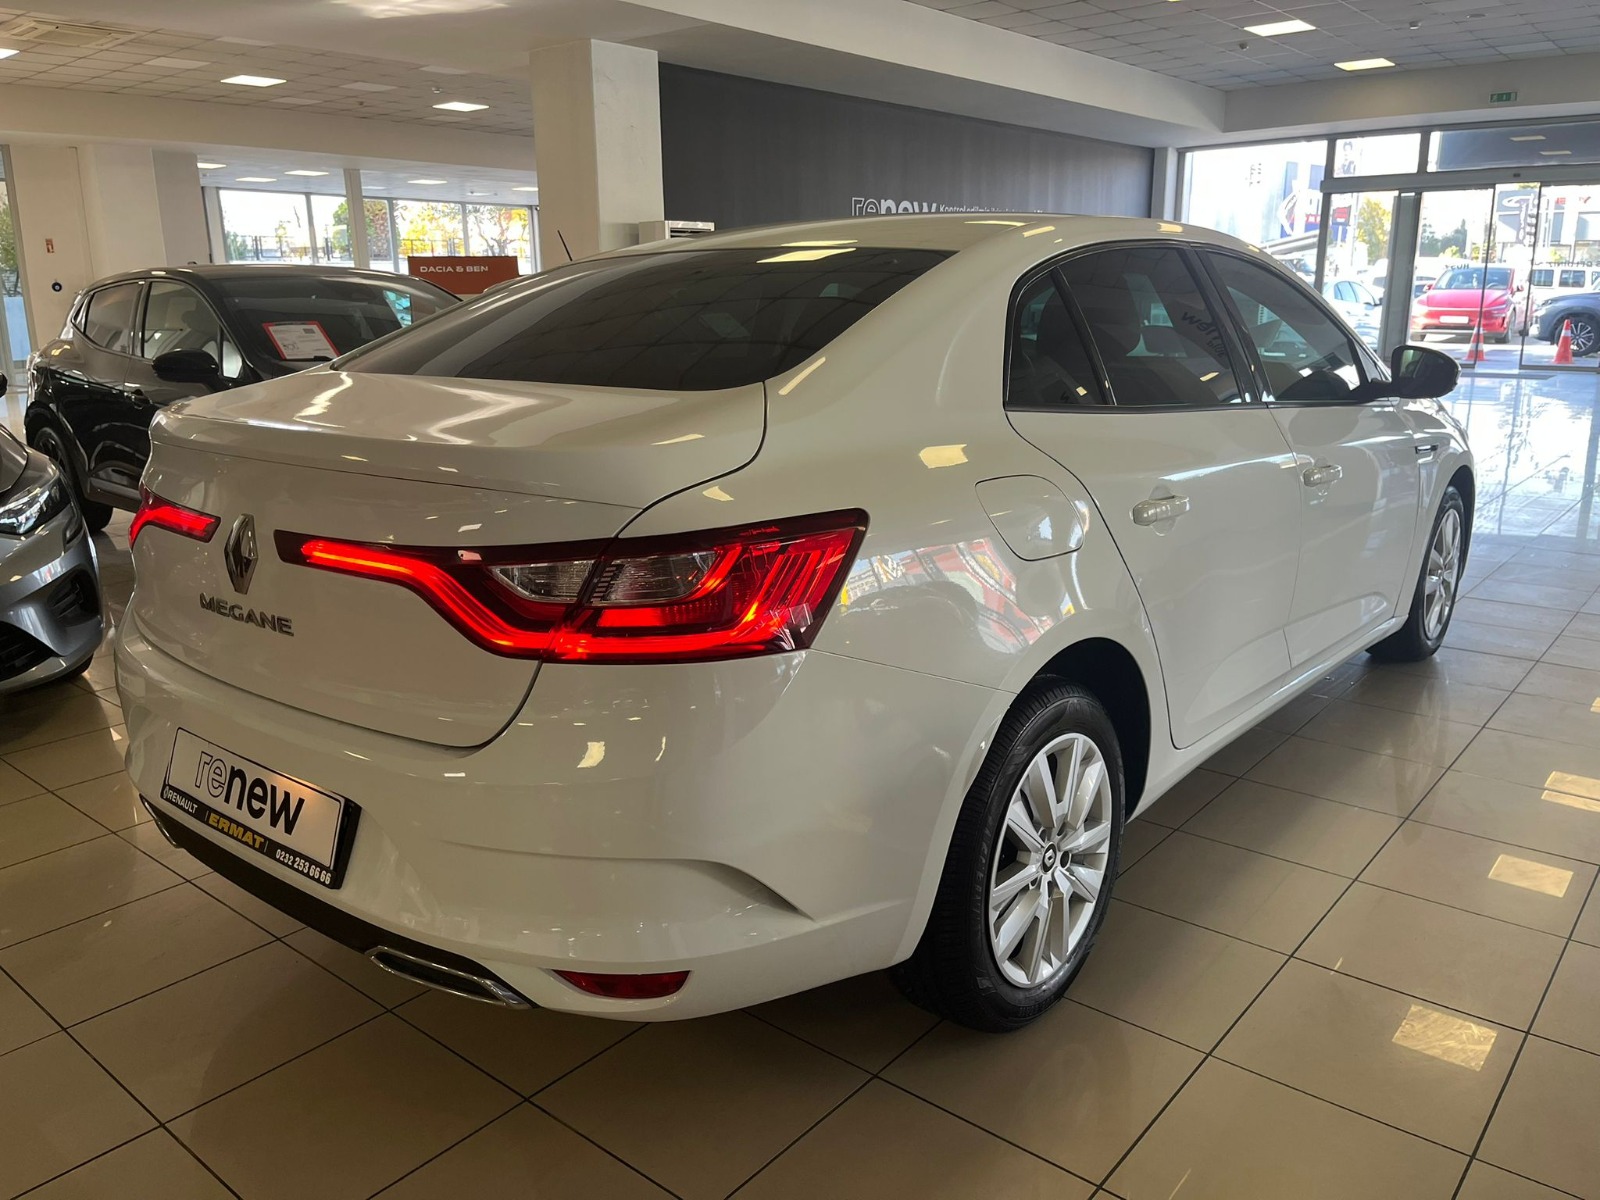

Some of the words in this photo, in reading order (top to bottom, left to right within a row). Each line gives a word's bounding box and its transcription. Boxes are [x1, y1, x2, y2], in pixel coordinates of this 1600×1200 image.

[852, 197, 937, 216] renew
[199, 592, 295, 637] MEGANE
[195, 750, 306, 836] renew
[167, 787, 198, 814] RENAULT
[208, 812, 265, 849] ERMAT
[275, 849, 293, 866] 0232
[294, 856, 309, 874] 253
[309, 864, 320, 879] 66
[320, 869, 331, 885] 66
